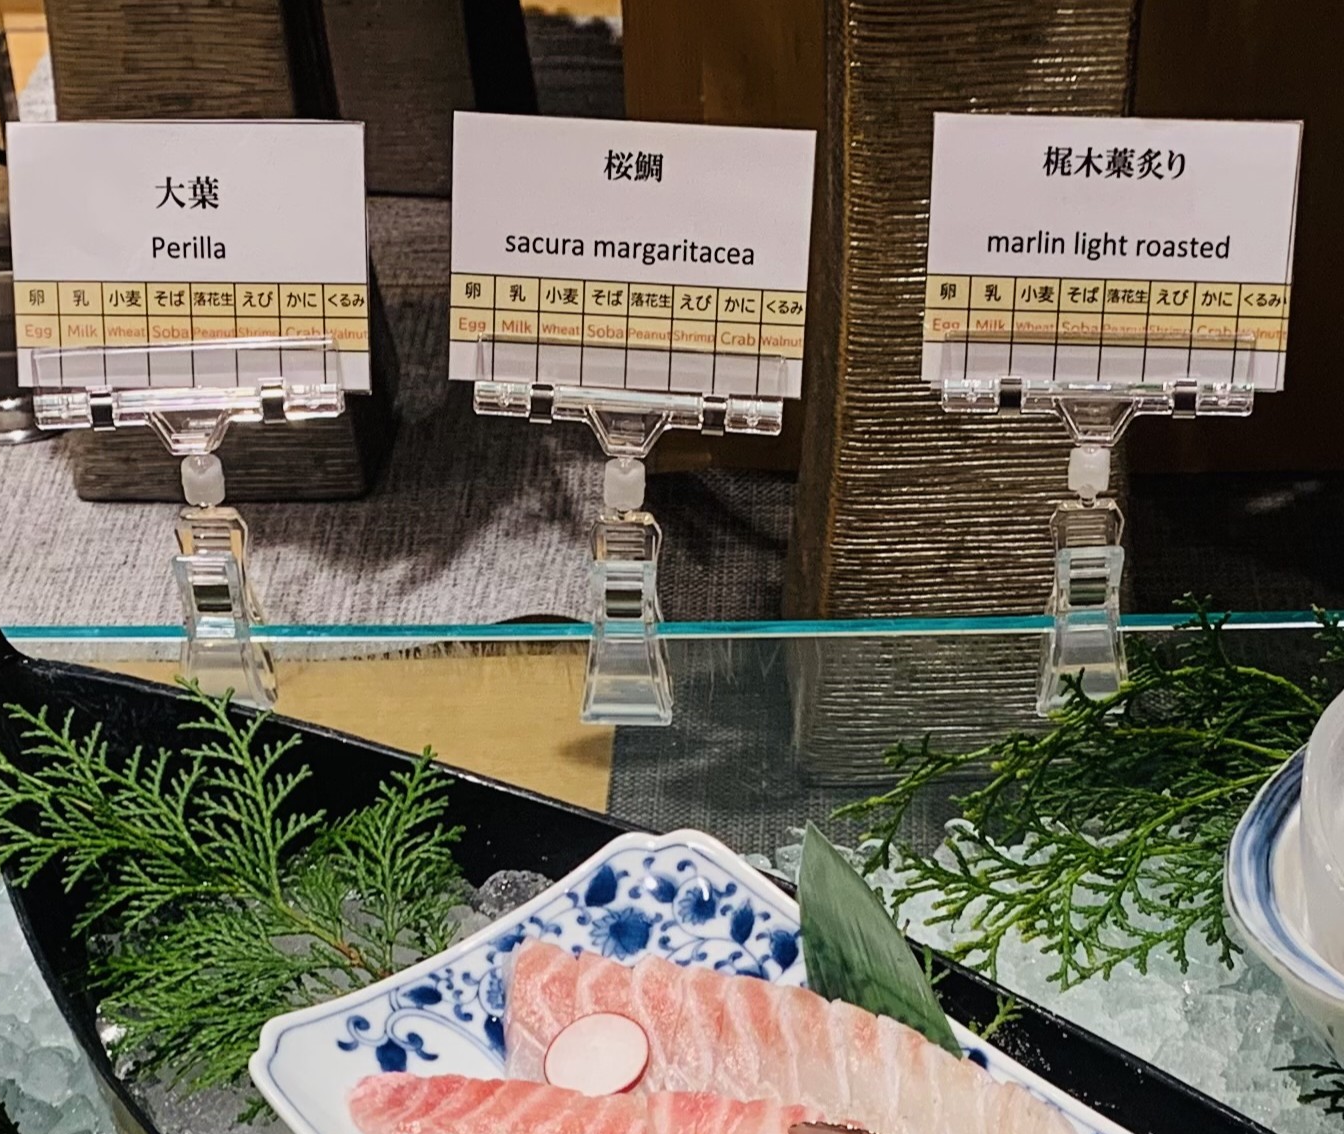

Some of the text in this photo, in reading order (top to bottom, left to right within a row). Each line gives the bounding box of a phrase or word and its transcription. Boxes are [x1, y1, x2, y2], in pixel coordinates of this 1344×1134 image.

[604, 150, 663, 182] 桜鯛
[155, 176, 219, 209] 大葉
[153, 236, 225, 259] Perilla
[506, 236, 754, 265] sacura margaritacea
[988, 230, 1230, 260] marlin light roasted
[29, 290, 365, 308] 卵 乳 小麦 そば 落花生 えび かに くるみ
[465, 283, 803, 316] 卵 乳 小麦 そば 落花生 えび かに くるみ
[940, 283, 1282, 307] 卵 乳 小麦 そば 落花生 えび かに くるみ
[25, 324, 53, 340] Egg
[67, 325, 97, 338] Milk
[152, 325, 189, 339] Soba
[459, 317, 487, 334] Egg
[502, 319, 532, 334] Milk
[587, 324, 625, 339] Soba
[627, 328, 670, 342] Peanut
[721, 331, 756, 346] Crab
